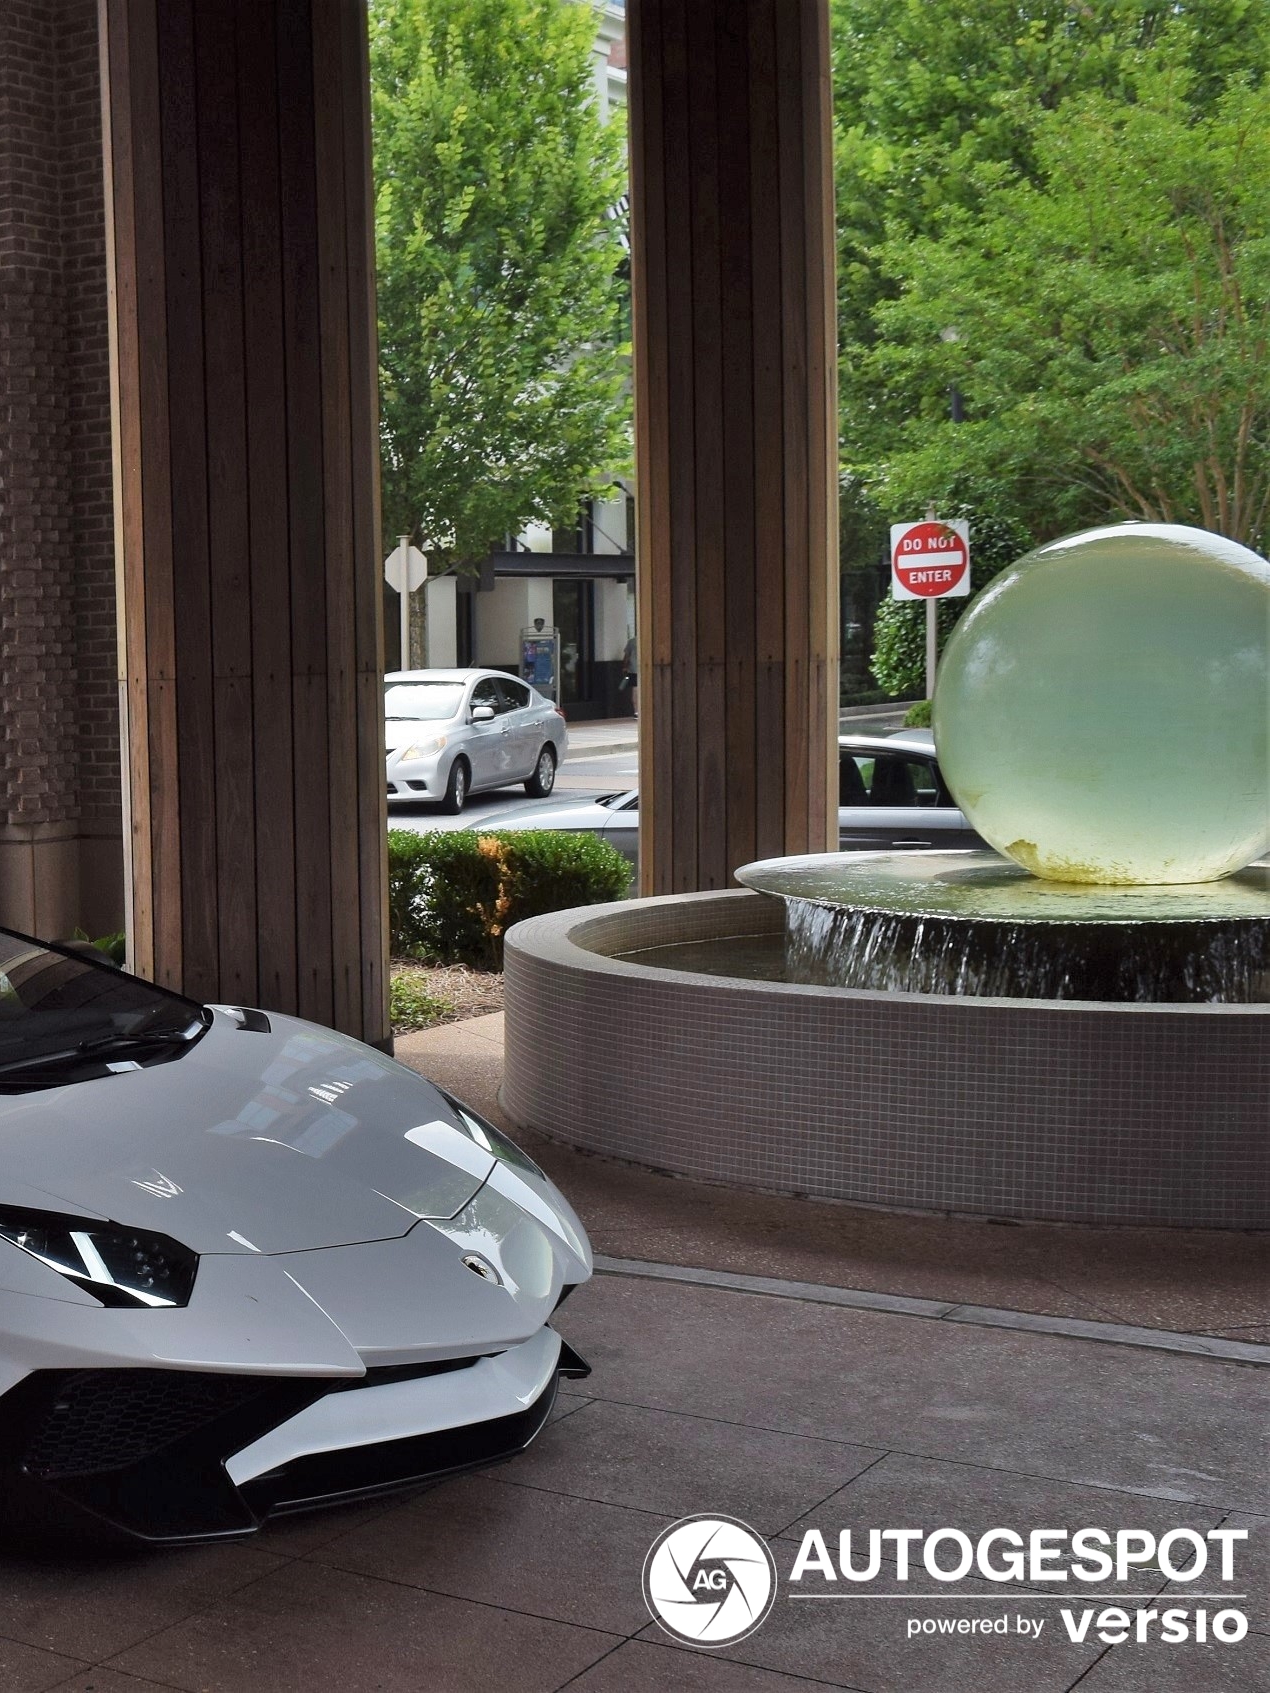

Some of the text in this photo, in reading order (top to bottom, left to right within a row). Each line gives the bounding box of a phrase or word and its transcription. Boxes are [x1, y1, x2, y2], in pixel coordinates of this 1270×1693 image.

[902, 535, 956, 552] DO NOT
[909, 569, 952, 584] ENTER
